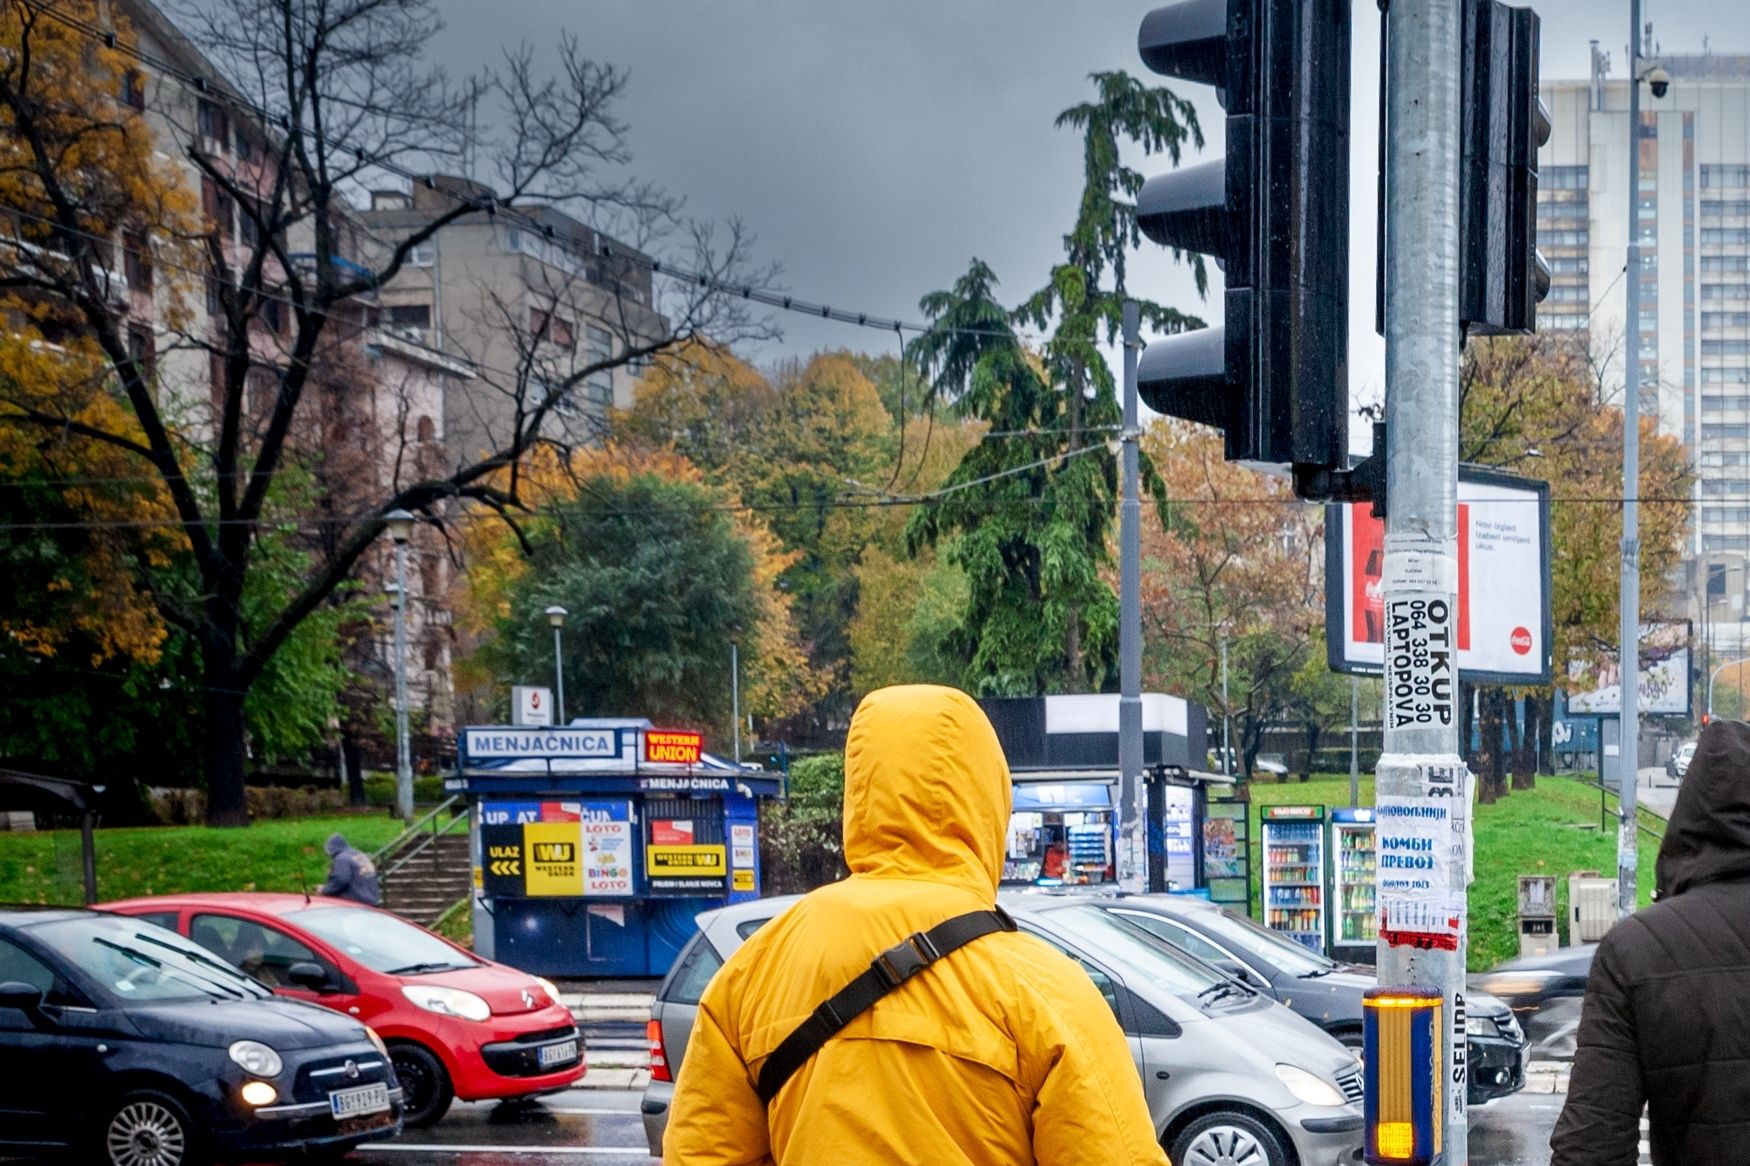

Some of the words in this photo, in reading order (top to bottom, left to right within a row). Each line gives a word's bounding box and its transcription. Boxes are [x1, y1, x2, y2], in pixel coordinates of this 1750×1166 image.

[1475, 520, 1492, 529] Novi
[1410, 599, 1426, 630] 064
[1412, 638, 1429, 668] 338
[1391, 601, 1414, 728] LAPTOPOVA
[1427, 599, 1451, 726] OTKUP
[1414, 676, 1430, 696] 30
[1415, 703, 1432, 723] 30
[475, 732, 609, 752] MENJAČNICA
[648, 734, 700, 745] WESTERN
[649, 745, 697, 761] UNION
[649, 778, 729, 790] MENJAČNICA
[586, 825, 622, 833] LOTO
[1382, 836, 1433, 851] КОМБИ
[489, 846, 520, 858] ULAZ
[588, 868, 629, 878] BINGO
[591, 881, 628, 890] LOTO
